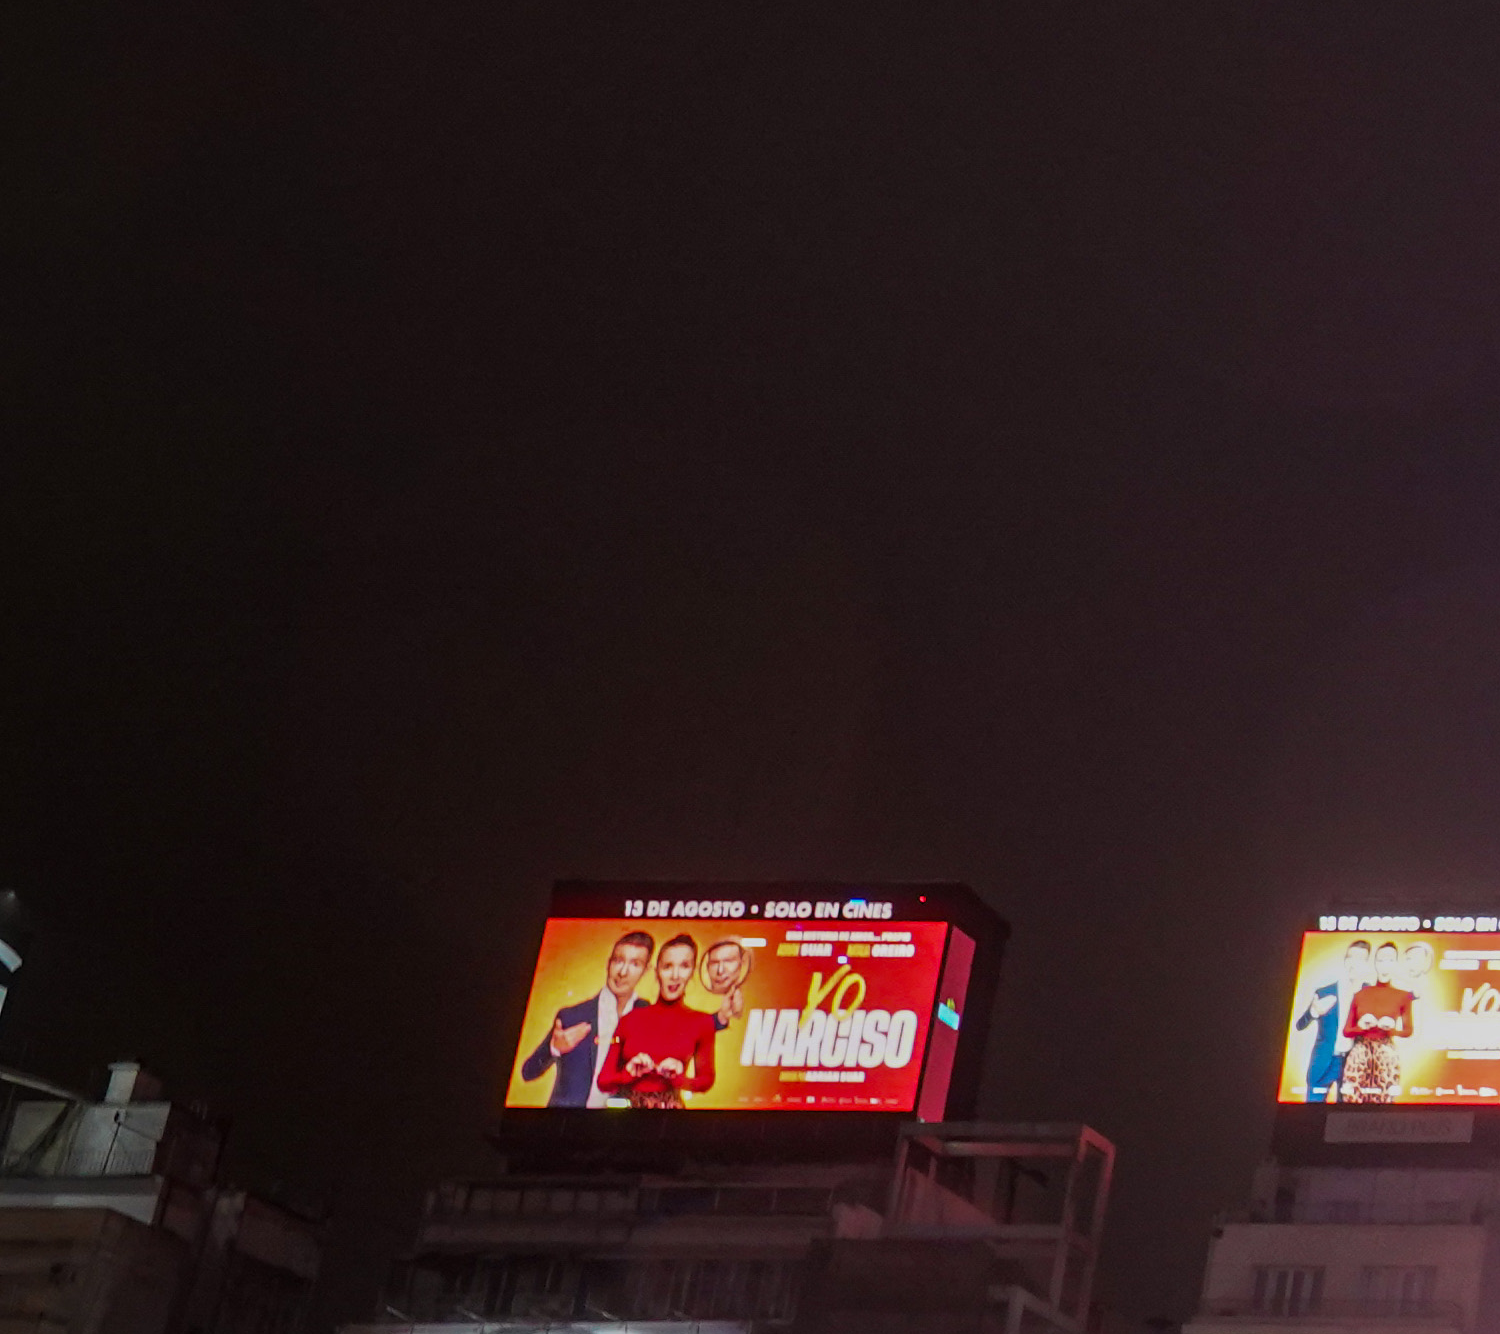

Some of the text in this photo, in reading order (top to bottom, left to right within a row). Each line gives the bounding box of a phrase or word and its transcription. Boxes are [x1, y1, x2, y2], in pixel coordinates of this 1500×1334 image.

[623, 900, 893, 920] 13 DE AGOSTO SOLO EN CINES
[800, 963, 867, 1027] YO
[739, 1008, 918, 1069] NARCISO
